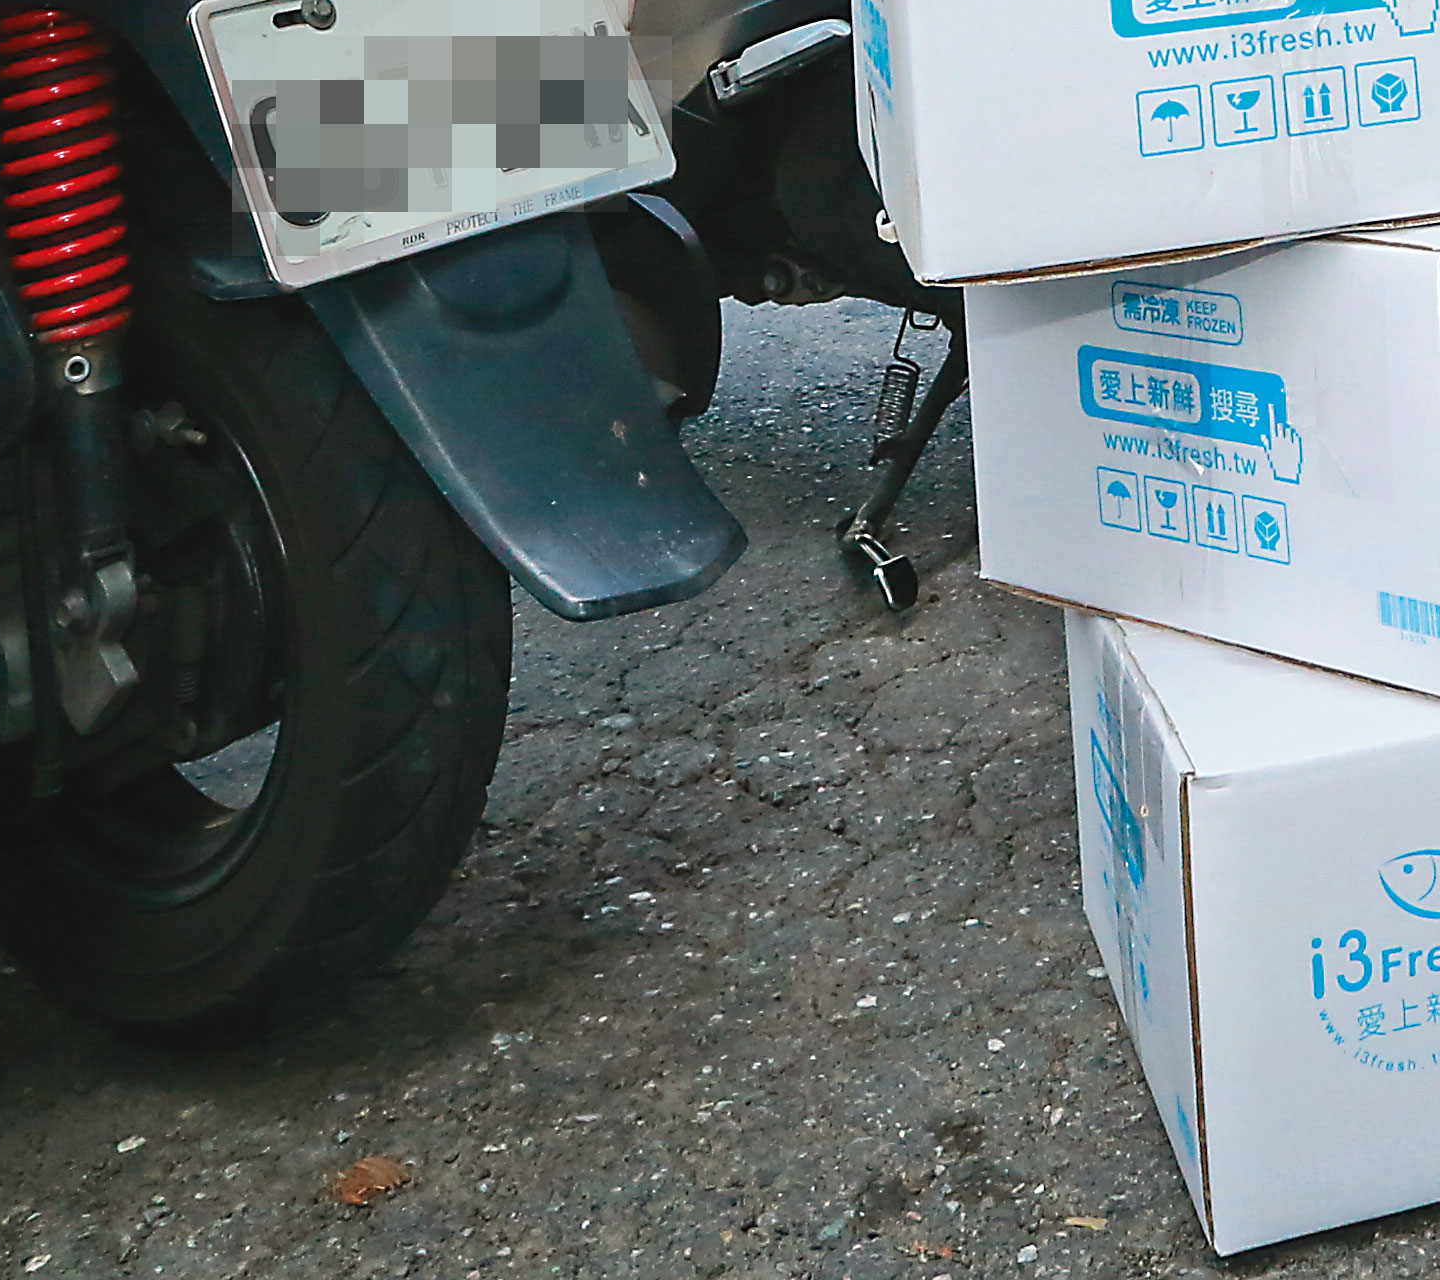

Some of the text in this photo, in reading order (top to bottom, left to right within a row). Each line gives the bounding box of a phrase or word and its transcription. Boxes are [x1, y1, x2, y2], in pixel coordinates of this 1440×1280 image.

[1148, 22, 1377, 69] www.i3fresh.tw
[445, 186, 582, 236] PROTECT THE FRAME
[1121, 292, 1180, 326] 需冷凍
[1185, 299, 1217, 316] KEEP
[1186, 315, 1236, 335] FROZEN
[1099, 369, 1195, 415] 愛上新鮮
[1210, 387, 1260, 428] 搜尋
[1103, 431, 1257, 476] www.i3fresh.tw
